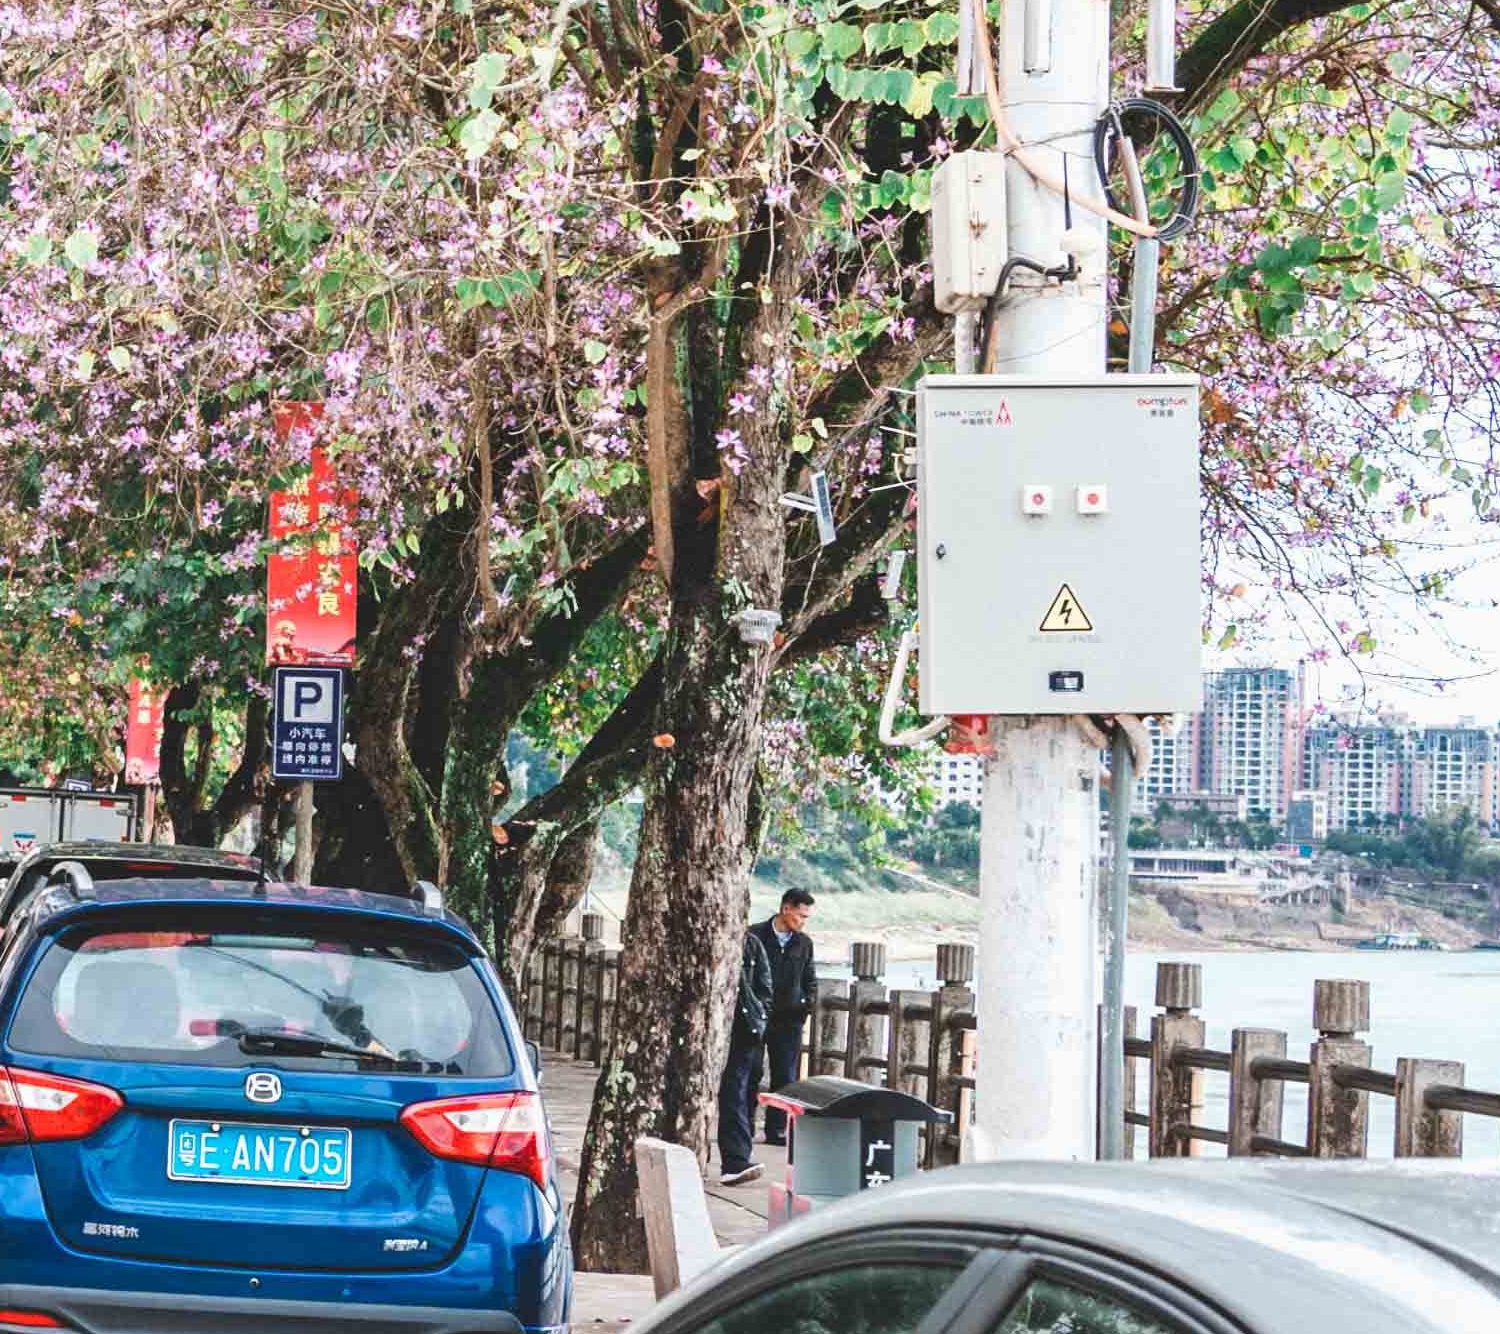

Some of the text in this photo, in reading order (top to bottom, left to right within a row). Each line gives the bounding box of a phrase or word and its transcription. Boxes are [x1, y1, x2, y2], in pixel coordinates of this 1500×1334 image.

[294, 681, 322, 718] P
[289, 727, 327, 739] 小汽车
